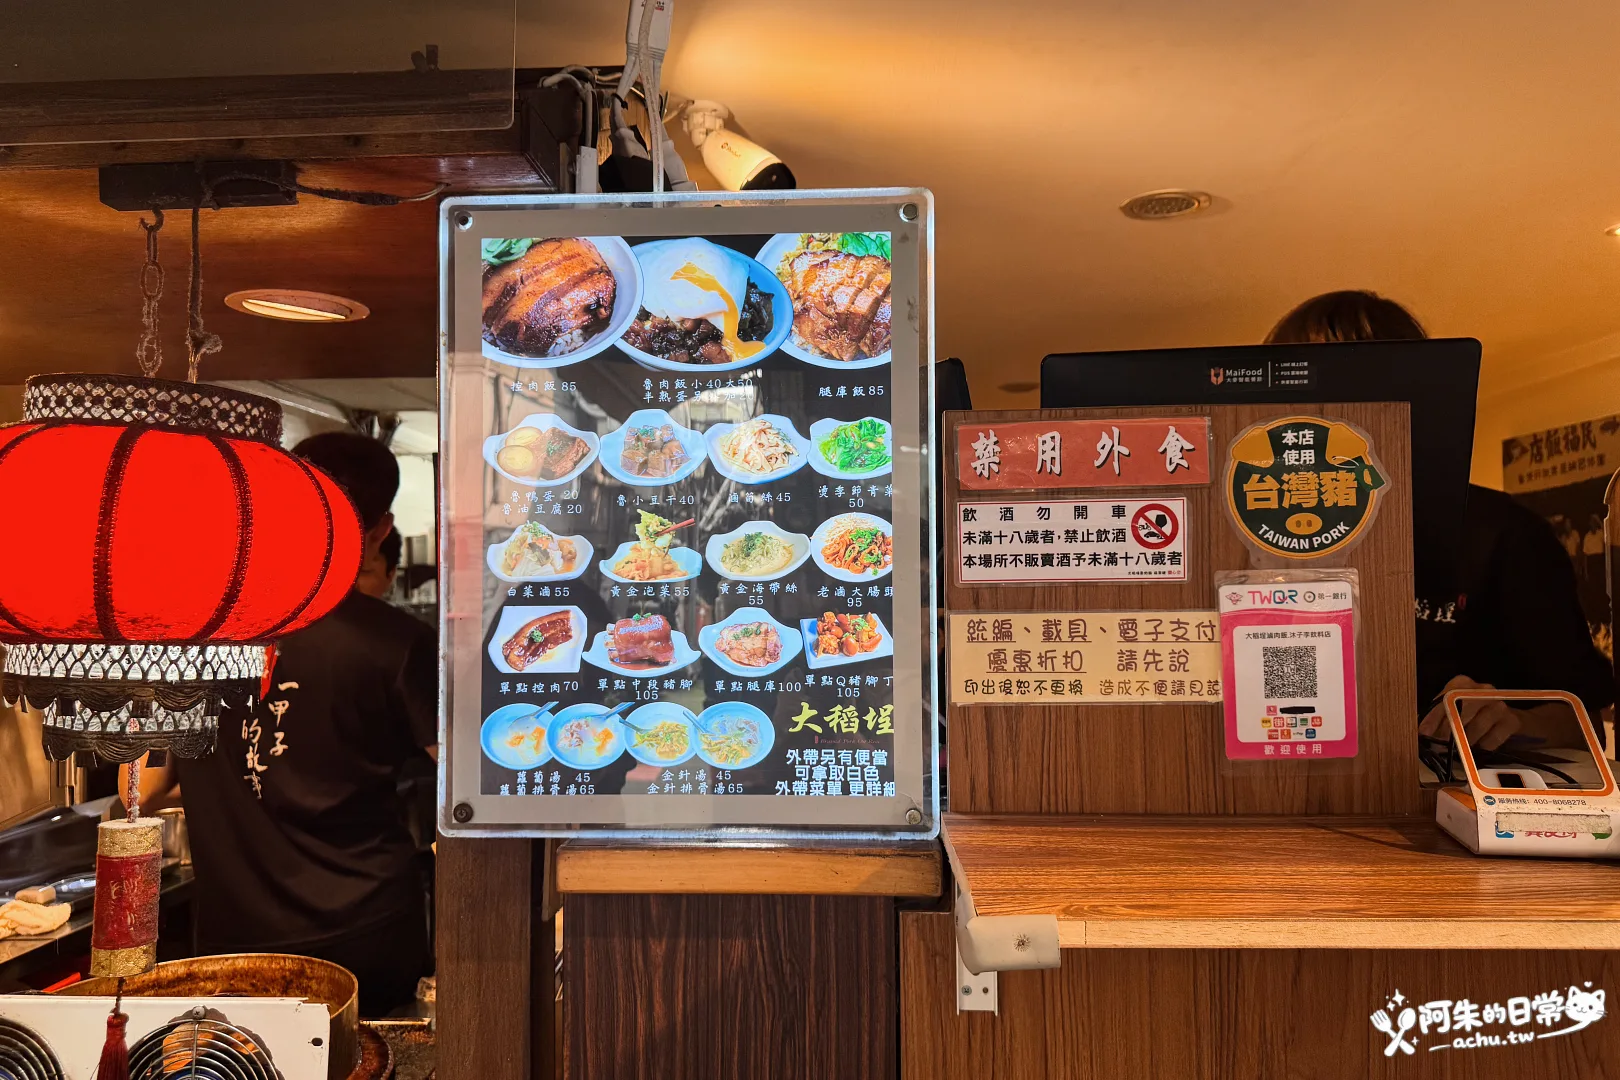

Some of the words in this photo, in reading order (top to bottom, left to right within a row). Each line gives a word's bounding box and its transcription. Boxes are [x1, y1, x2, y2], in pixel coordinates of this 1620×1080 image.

[1226, 368, 1263, 377] MaiFood
[1281, 429, 1315, 446] 本店
[970, 425, 1196, 480] 禁用外食
[1282, 449, 1315, 466] 使用
[1243, 470, 1358, 511] 台灣豬
[848, 498, 864, 508] 50
[962, 505, 1127, 522] 飲酒勿開車
[1258, 524, 1309, 550] TAIWAN
[1312, 521, 1350, 548] PORK
[962, 551, 1183, 569] 本場所不販賣酒予未滿十八歲者
[748, 595, 764, 605] 55
[847, 597, 863, 607] 95
[987, 649, 1084, 673] 優惠折扣
[1117, 649, 1190, 673] 請先說
[636, 690, 659, 700] 105
[837, 687, 860, 698] 105
[964, 679, 1083, 696] 印出後恕不更換
[268, 681, 300, 757] 一甲子
[788, 701, 895, 735] 大稻埕
[786, 749, 888, 766] 外帶另有便當
[1264, 743, 1322, 755] 歡迎使用
[794, 765, 880, 781] 可拿取白色
